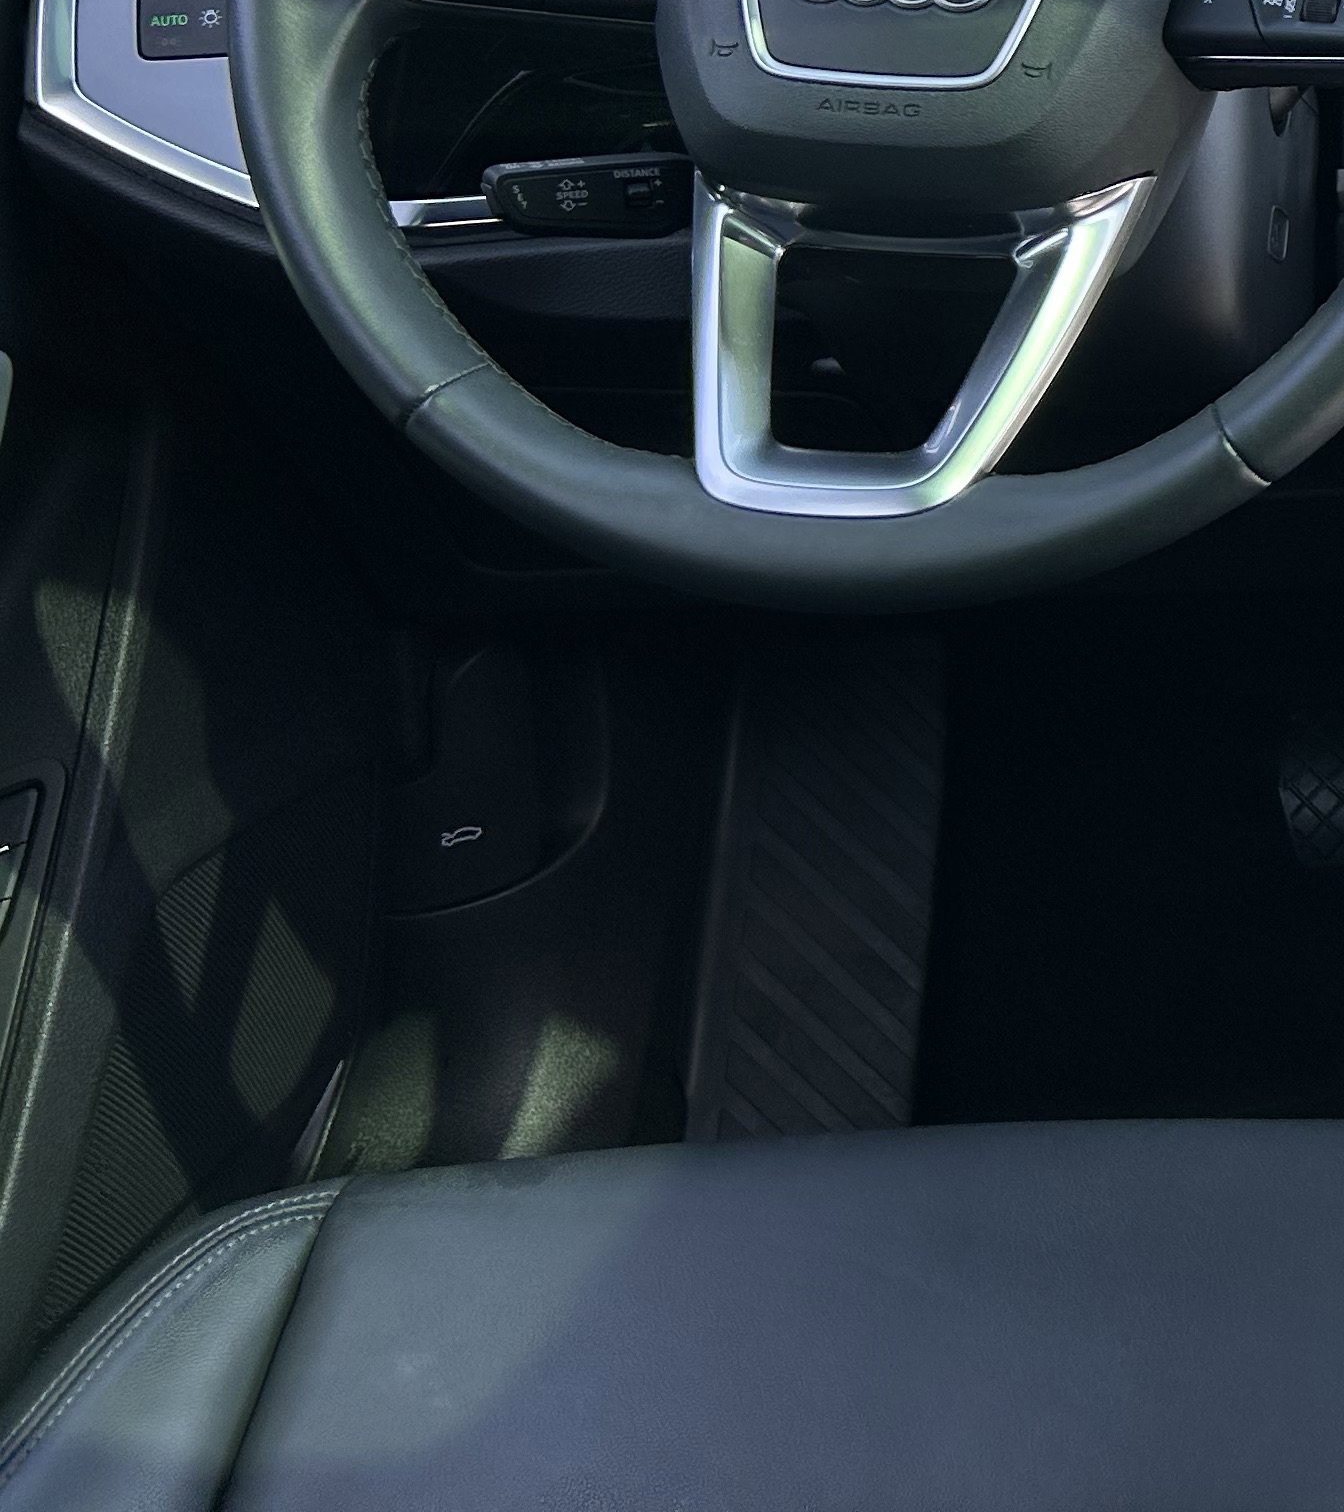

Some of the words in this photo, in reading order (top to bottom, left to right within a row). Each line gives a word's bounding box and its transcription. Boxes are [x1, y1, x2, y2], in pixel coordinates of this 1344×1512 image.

[150, 14, 189, 27] AUTO
[817, 97, 922, 118] AIRBAG
[613, 167, 661, 179] DISTANCE
[555, 190, 589, 201] SPEED
